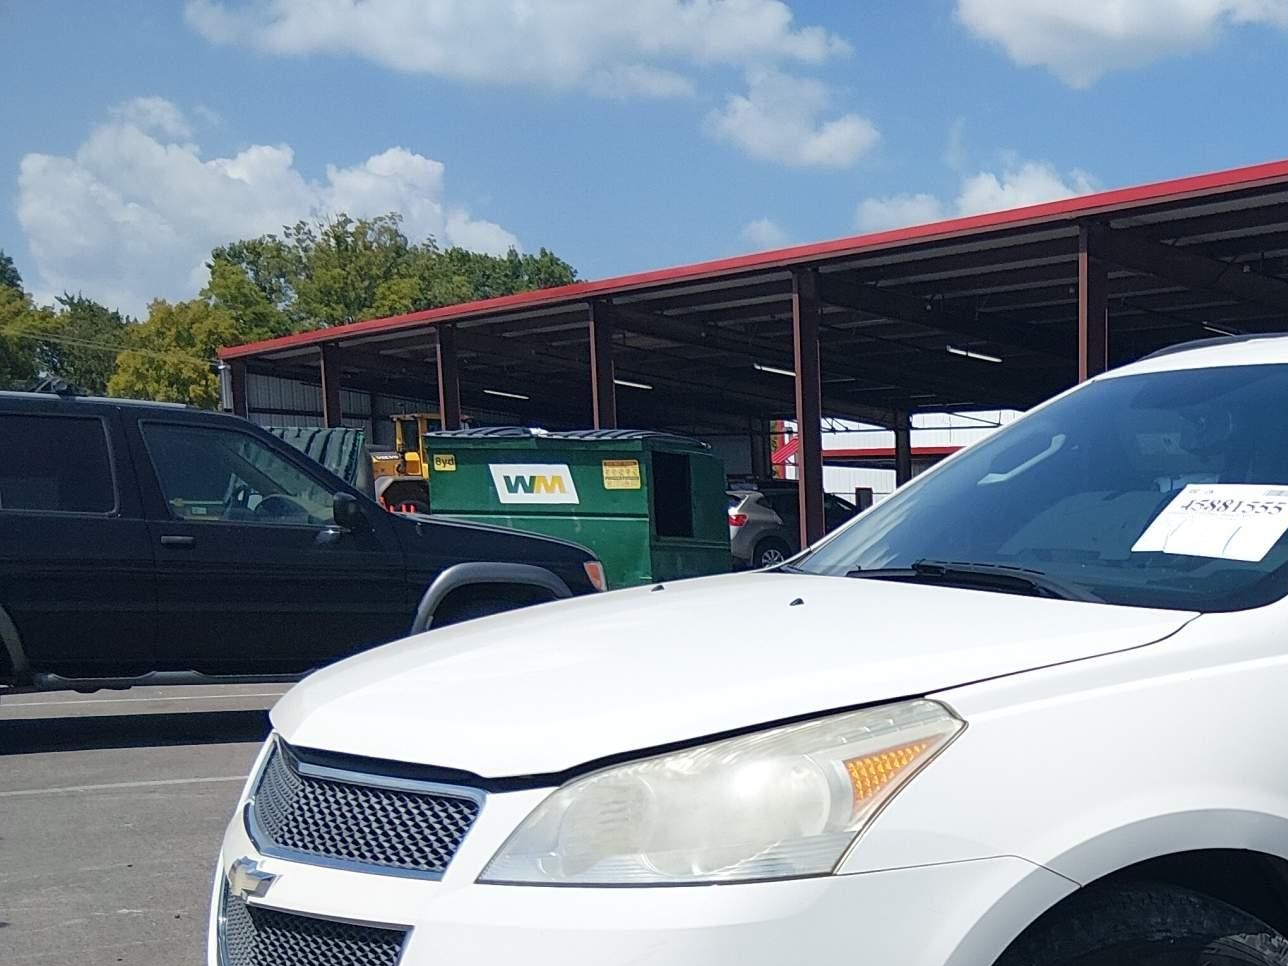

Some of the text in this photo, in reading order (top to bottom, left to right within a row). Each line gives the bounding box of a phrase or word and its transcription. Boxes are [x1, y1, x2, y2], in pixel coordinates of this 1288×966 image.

[435, 457, 454, 468] 8yd
[503, 475, 568, 494] WM
[1181, 499, 1287, 515] 45881555
